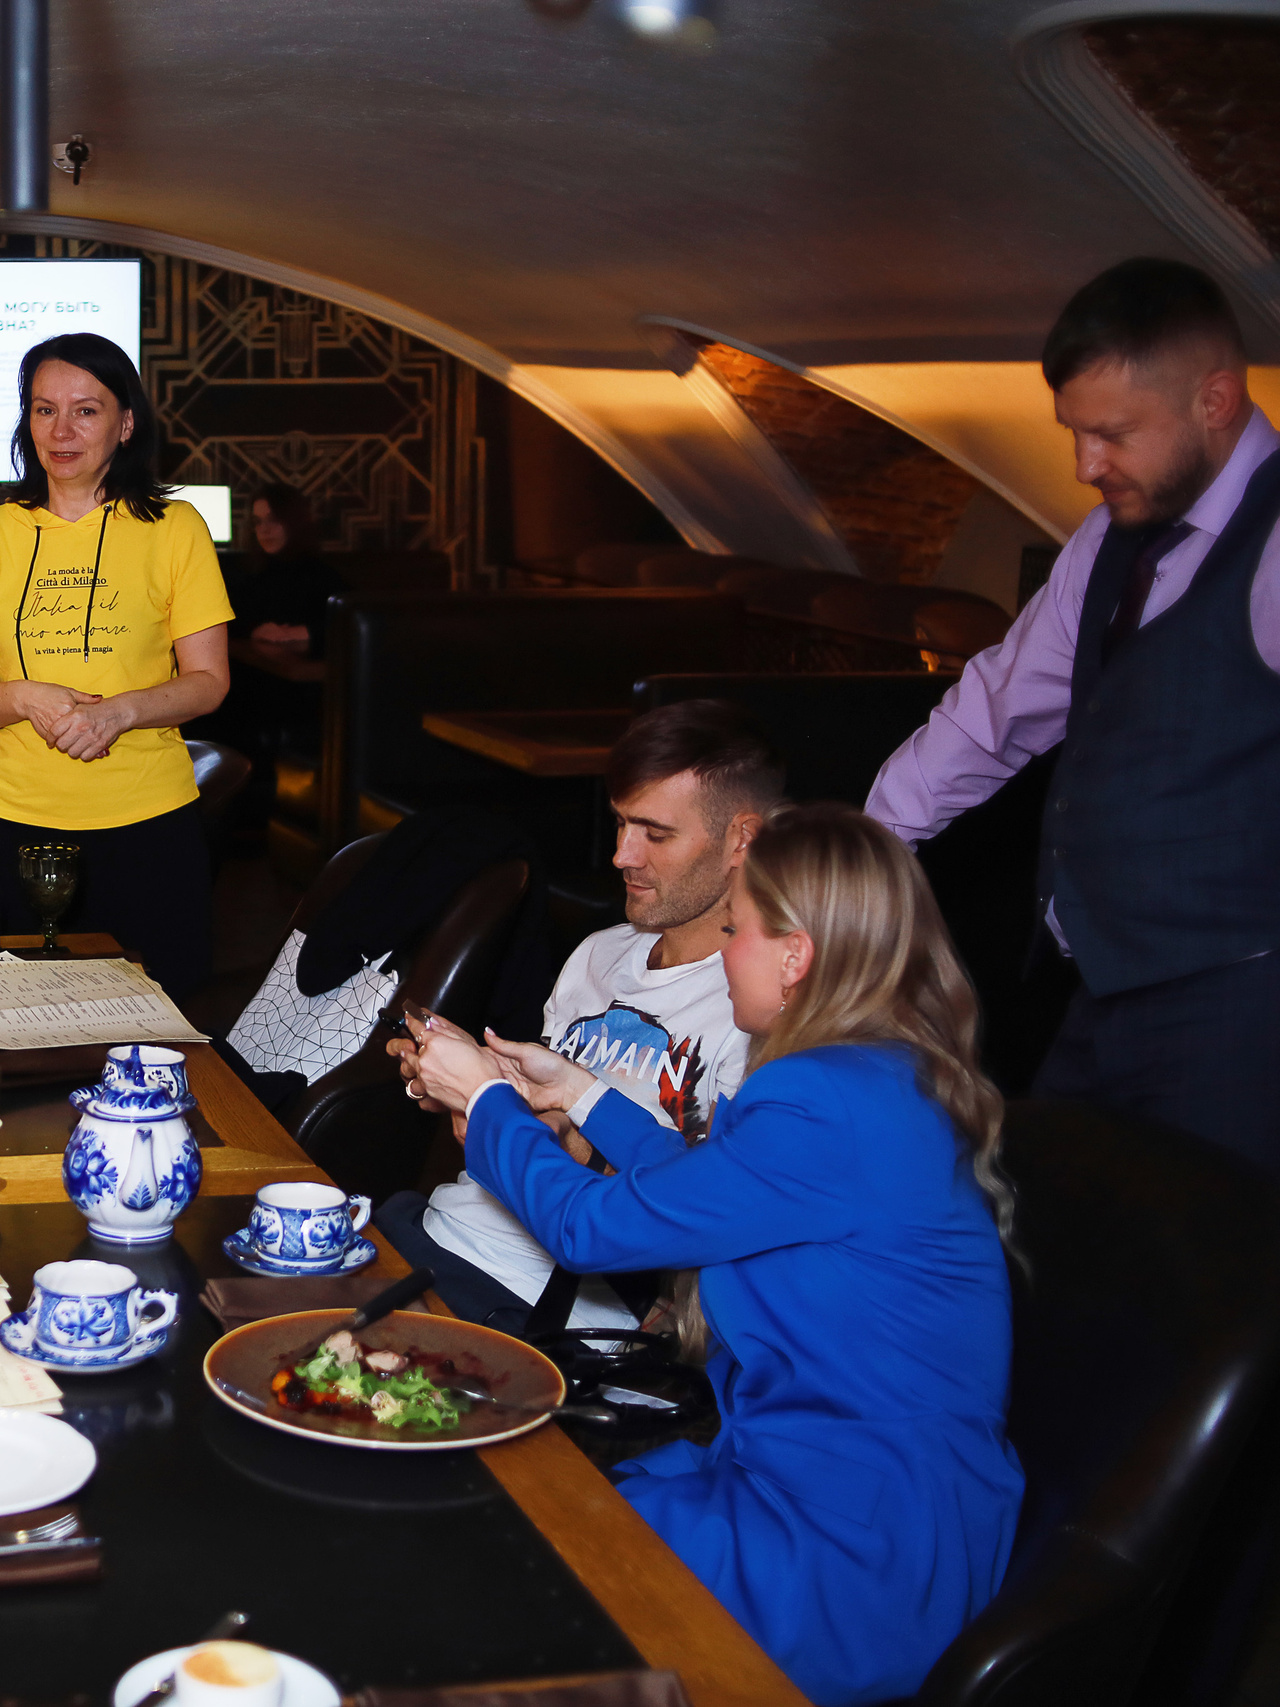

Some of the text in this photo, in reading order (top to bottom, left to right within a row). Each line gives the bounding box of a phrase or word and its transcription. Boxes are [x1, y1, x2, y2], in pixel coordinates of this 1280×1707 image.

[4, 301, 49, 313] МОГУ
[55, 301, 101, 312] БЫТЬ
[47, 566, 94, 576] La moda è la
[36, 577, 58, 587] Città
[60, 576, 70, 586] di
[13, 590, 119, 621] Italia il
[34, 647, 41, 655] la
[56, 646, 61, 654] è
[62, 646, 81, 655] piena
[91, 645, 113, 655] magia
